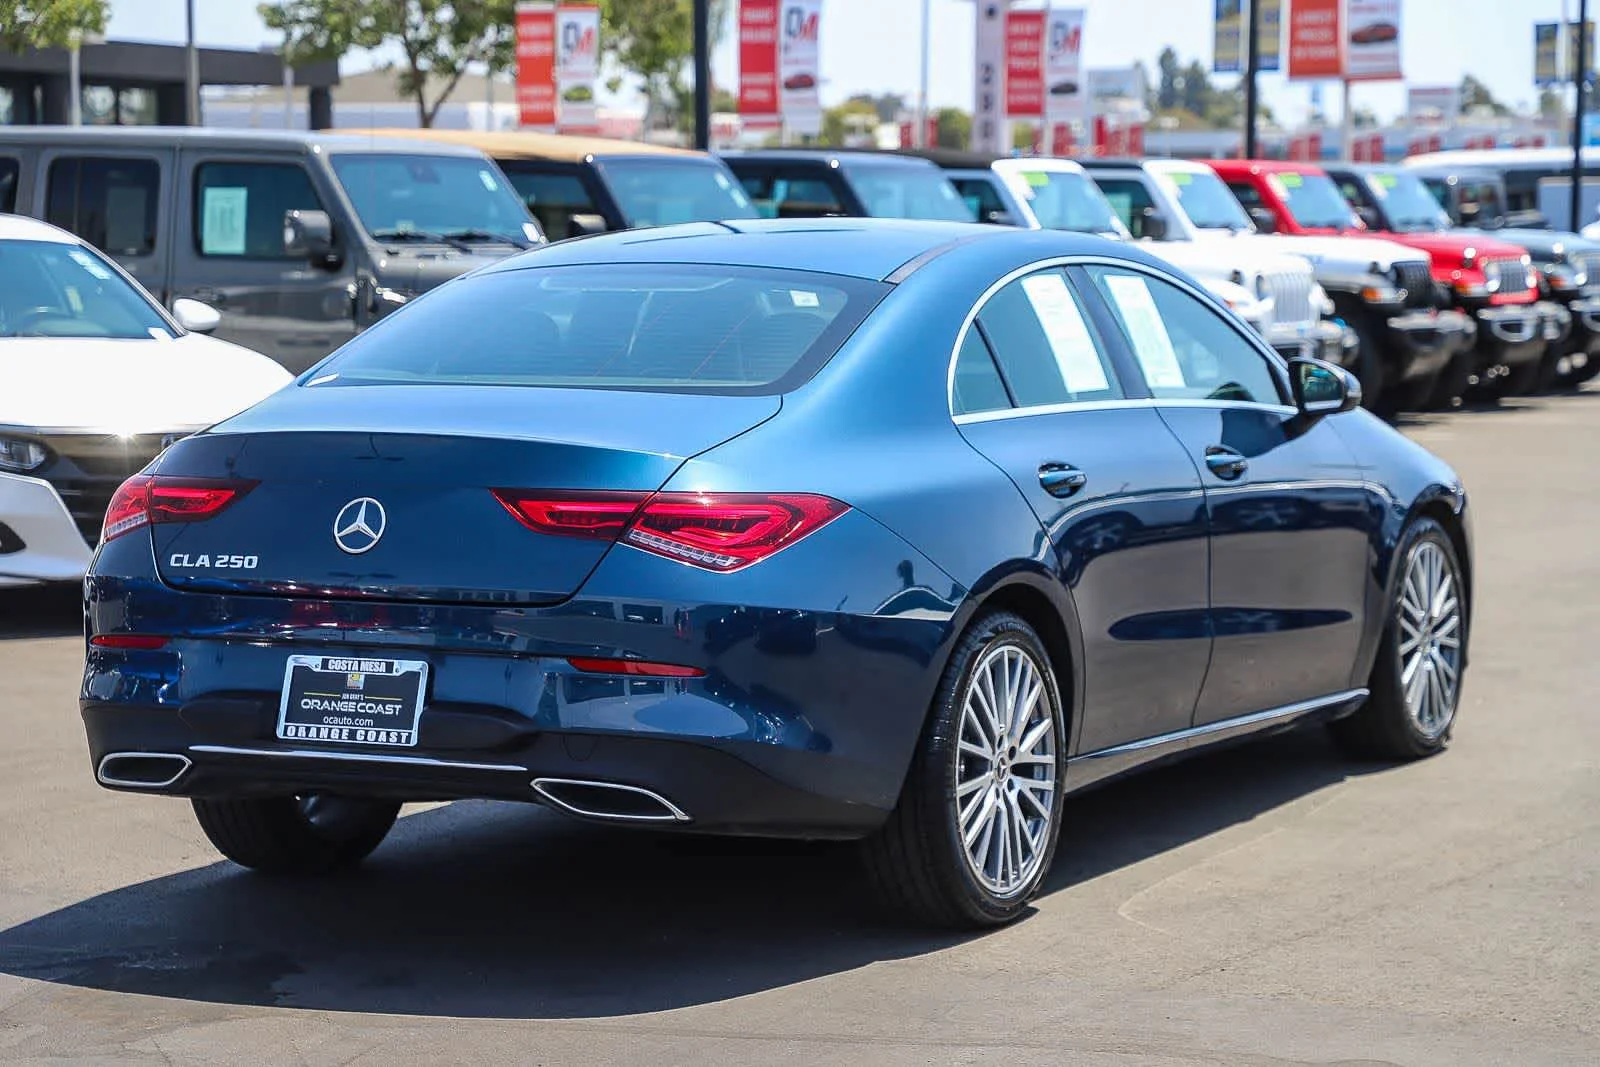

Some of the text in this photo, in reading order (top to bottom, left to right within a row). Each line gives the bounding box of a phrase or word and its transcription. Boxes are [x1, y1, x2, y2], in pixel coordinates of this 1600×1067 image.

[170, 554, 258, 568] CLA 250
[327, 659, 386, 673] COSTA MESA
[323, 715, 374, 727] ocauto.com
[287, 726, 409, 744] ORANGE COAST
